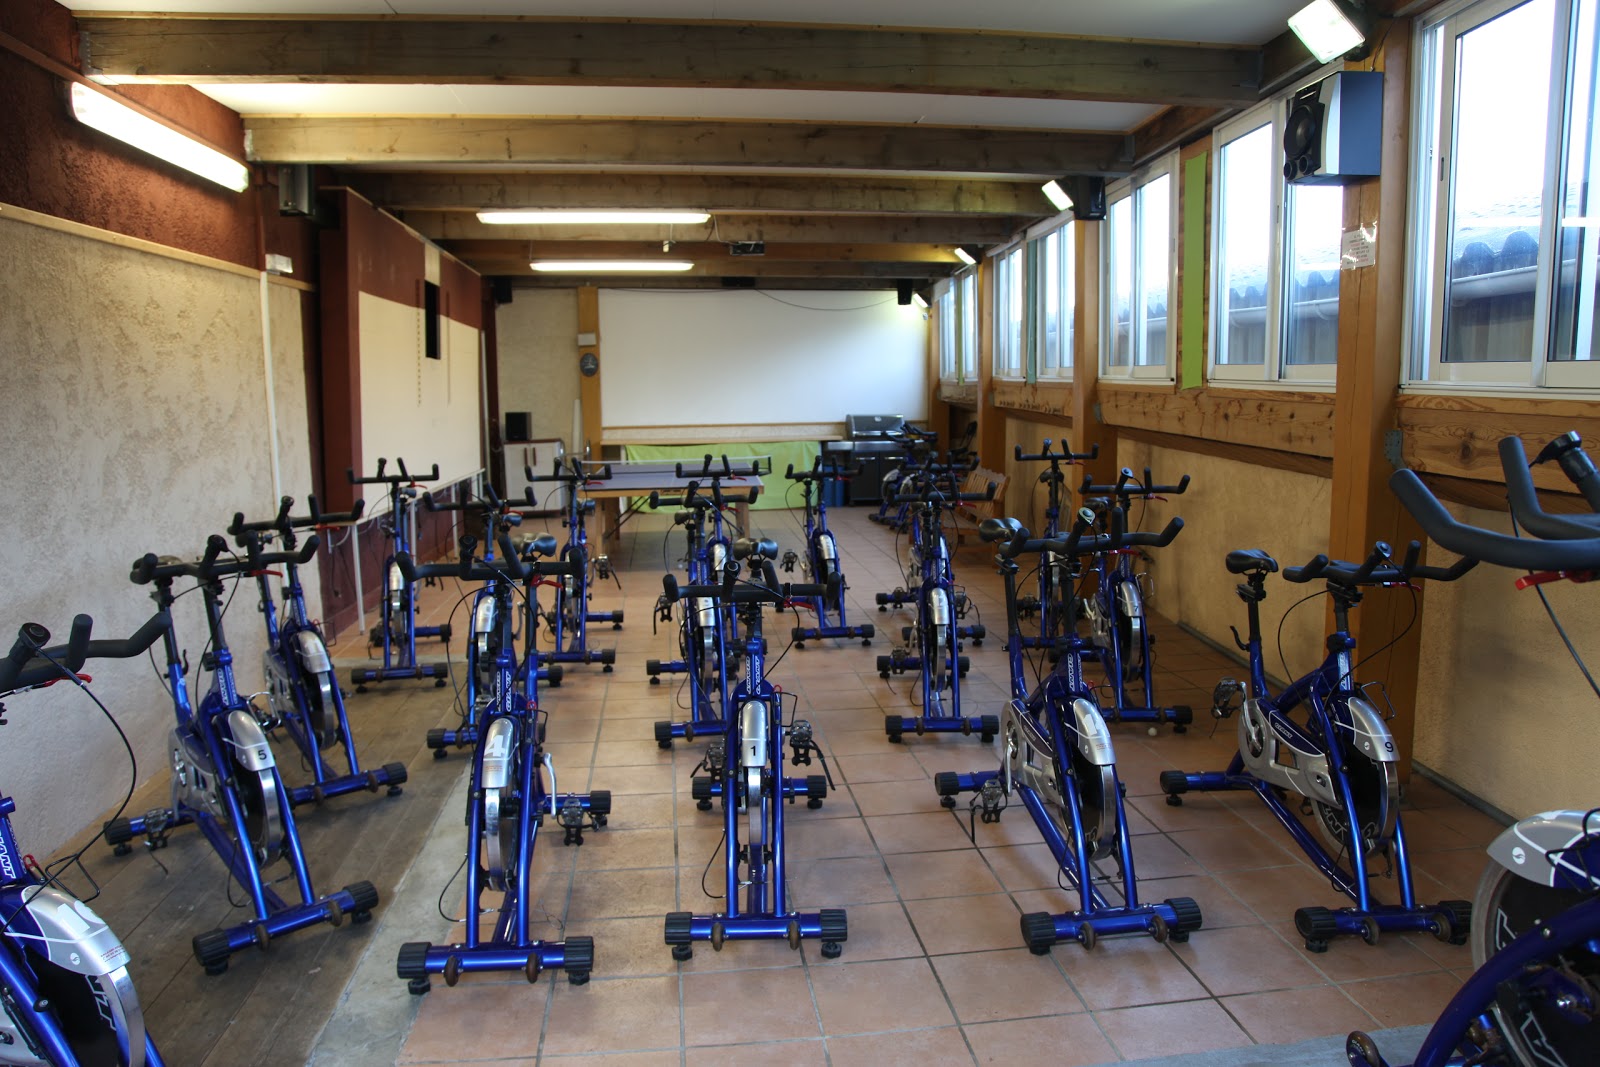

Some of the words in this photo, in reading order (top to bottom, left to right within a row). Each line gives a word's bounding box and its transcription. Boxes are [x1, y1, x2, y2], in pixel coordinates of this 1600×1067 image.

[1067, 653, 1075, 692] GIANT
[484, 734, 506, 757] 4
[750, 745, 756, 757] 1
[1384, 741, 1394, 753] 9
[257, 749, 267, 761] 5
[0, 829, 16, 879] ANT
